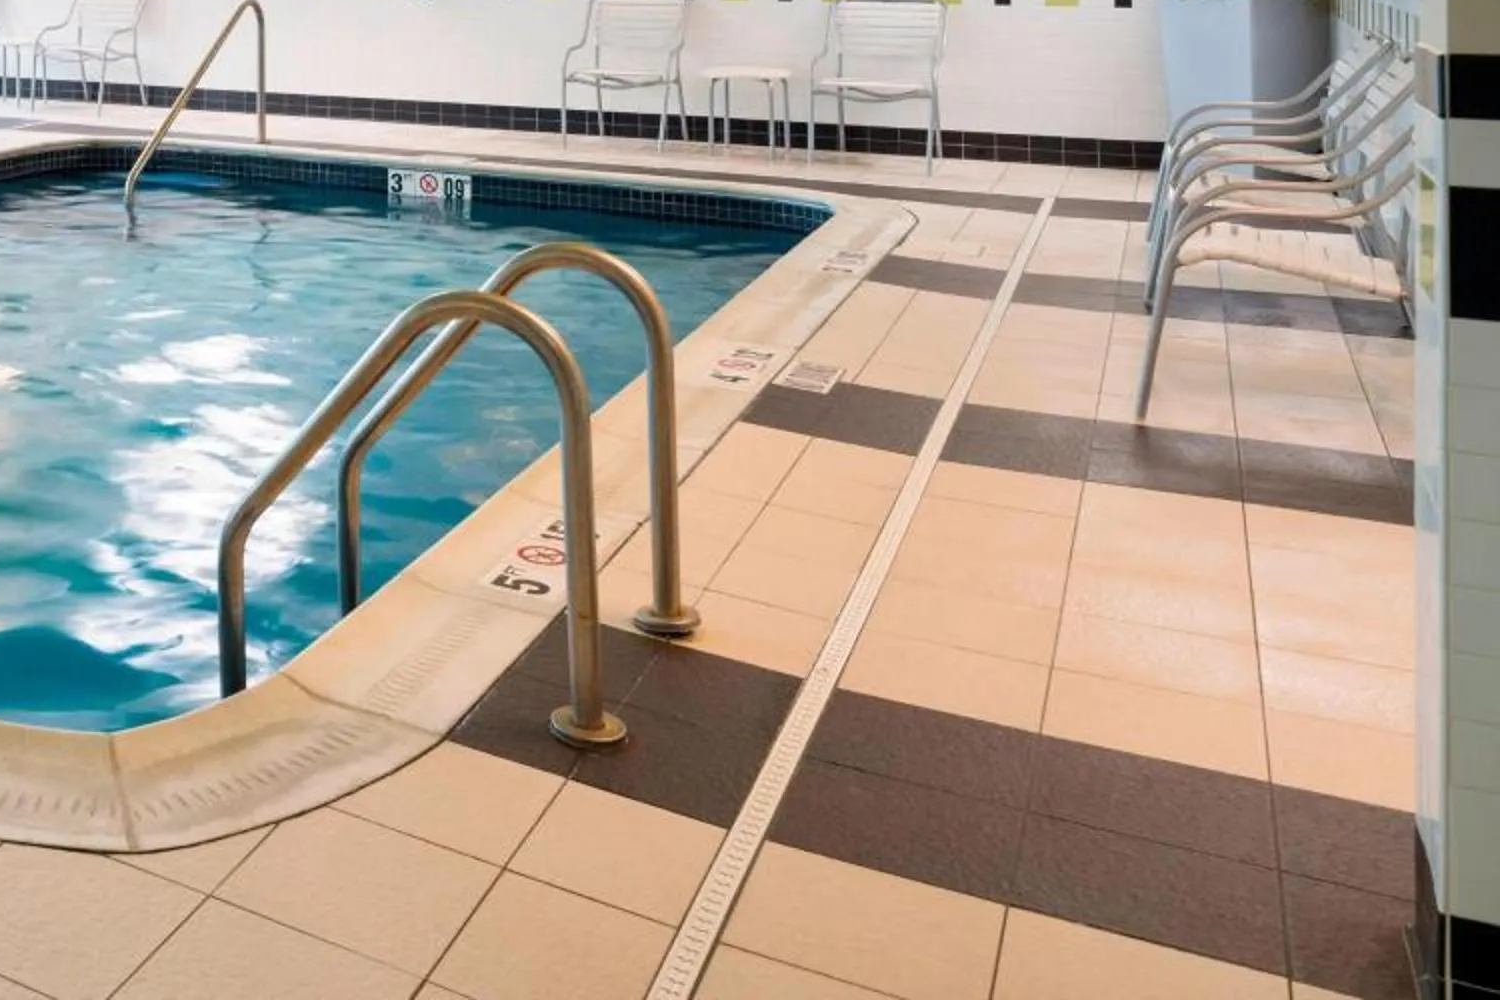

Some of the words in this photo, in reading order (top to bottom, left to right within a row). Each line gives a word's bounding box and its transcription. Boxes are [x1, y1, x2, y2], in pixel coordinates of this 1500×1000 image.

[391, 173, 403, 193] 3
[444, 178, 464, 199] 09
[490, 573, 550, 595] 5
